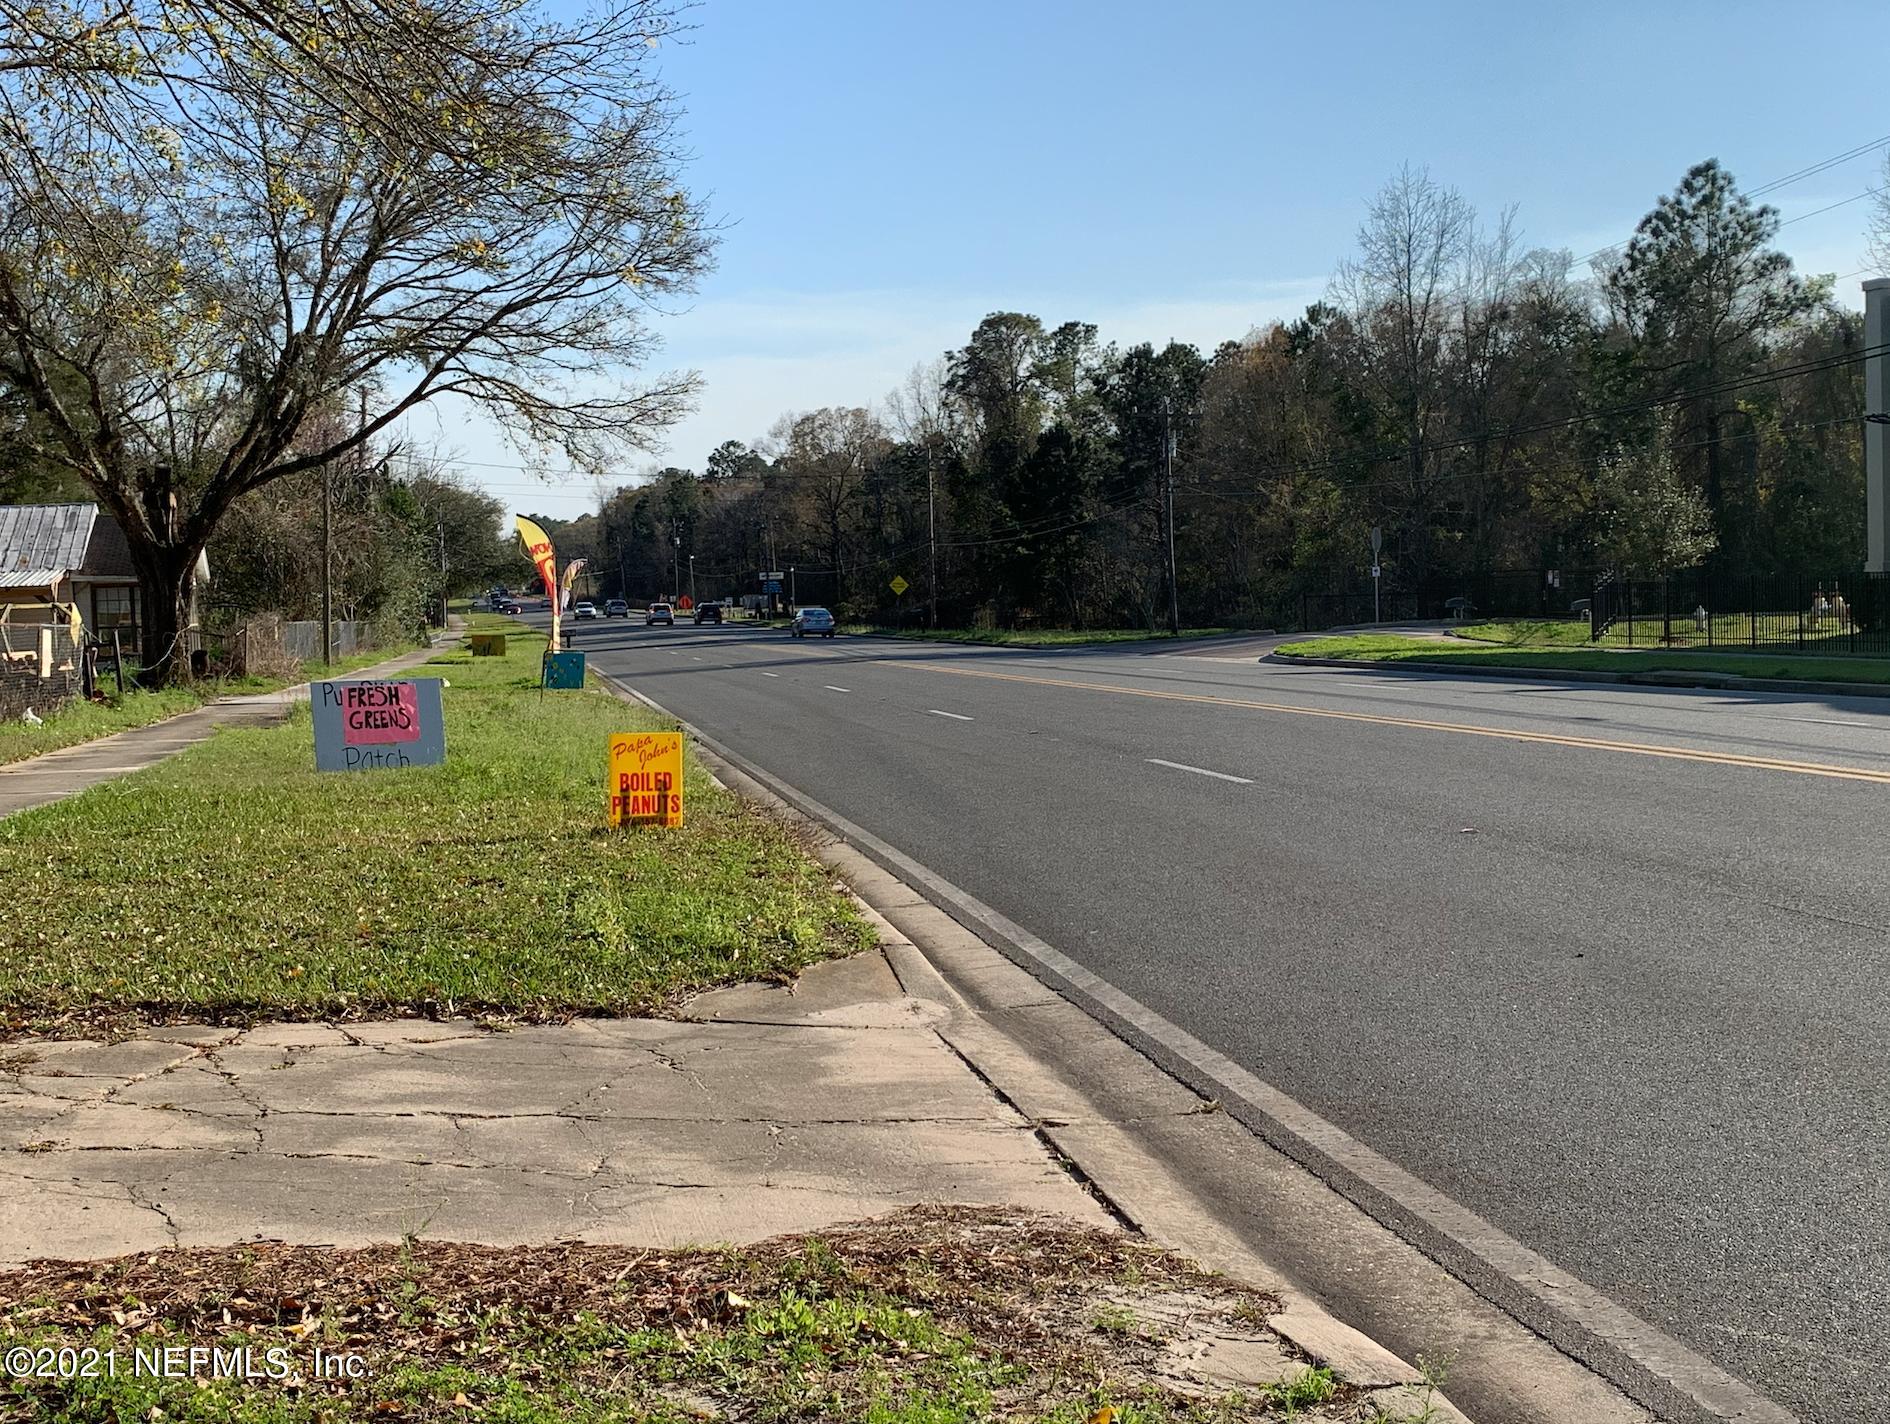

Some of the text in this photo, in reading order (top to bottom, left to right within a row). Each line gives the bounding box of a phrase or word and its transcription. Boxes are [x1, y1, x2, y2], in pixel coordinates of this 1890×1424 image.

[347, 686, 401, 708] FRESH
[349, 708, 411, 730] GREENS
[342, 746, 411, 769] Patch
[613, 735, 653, 760] Papa
[639, 737, 678, 770] John's
[619, 772, 673, 792] BOILED
[612, 793, 680, 815] PEANUTS
